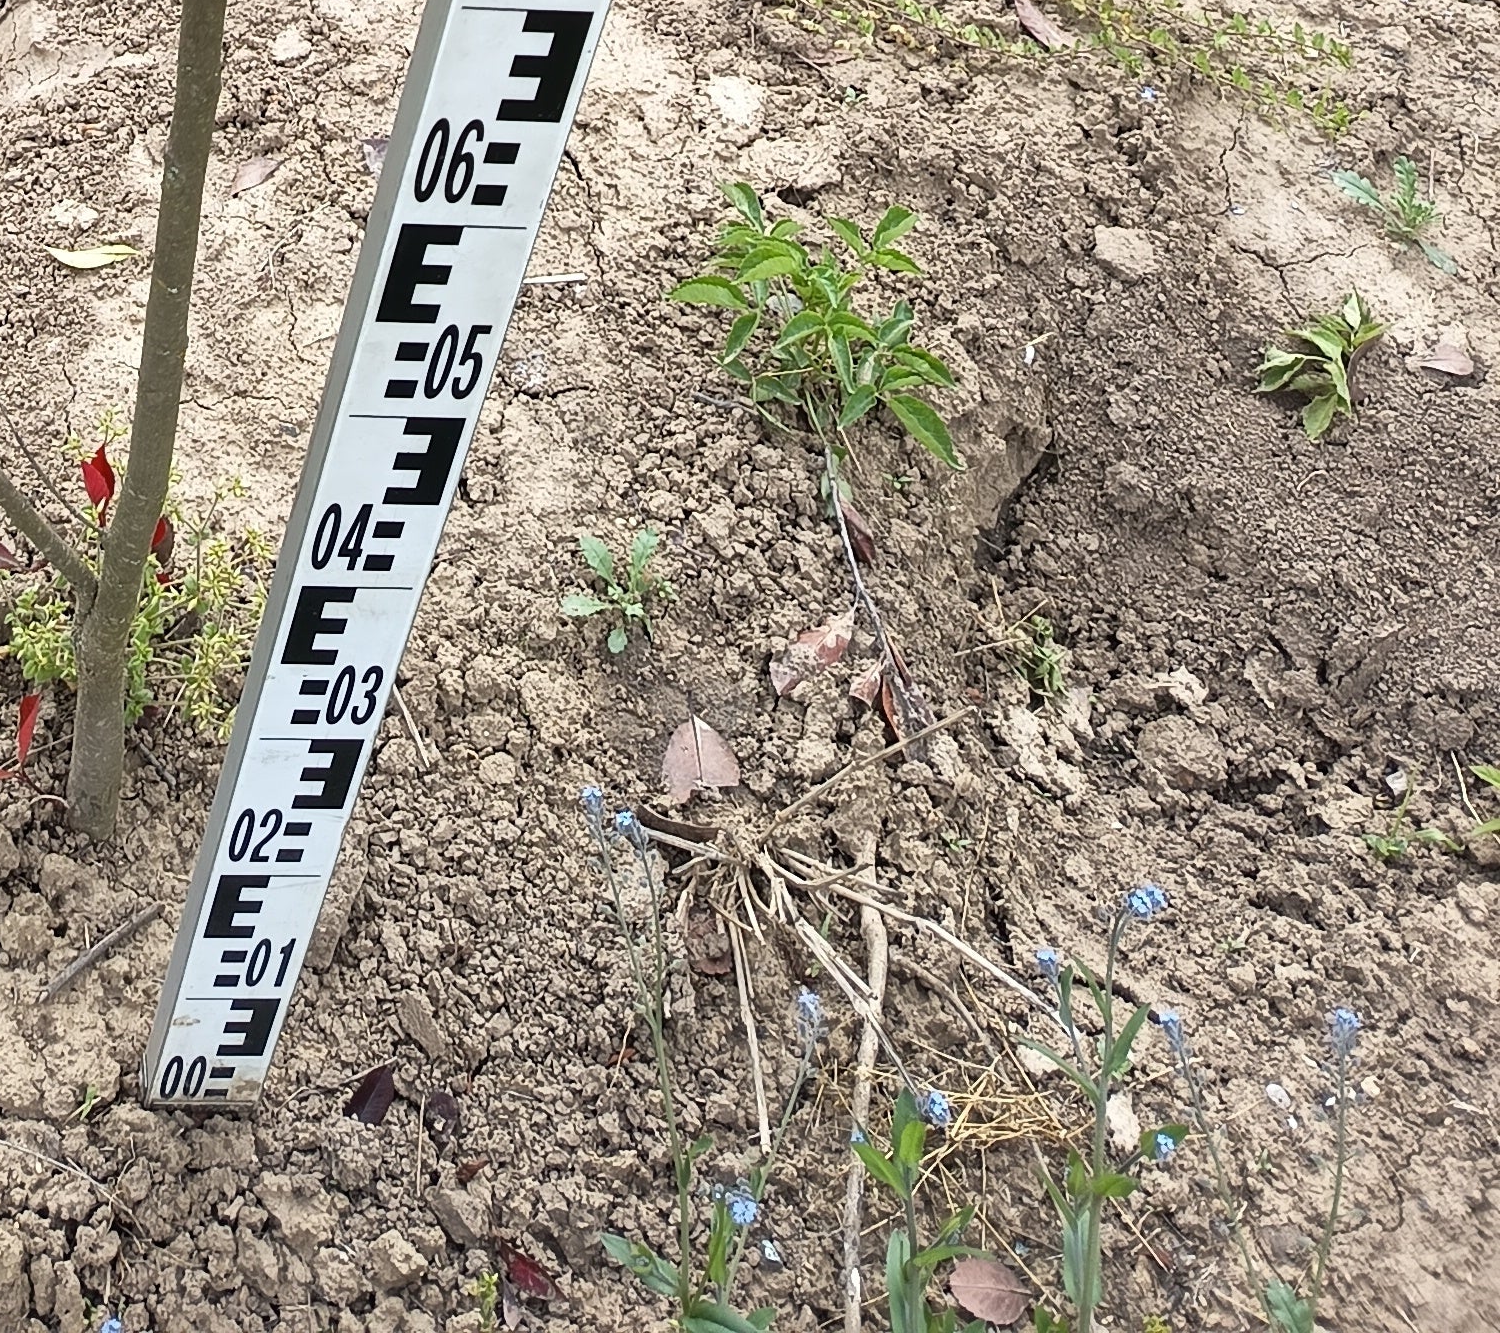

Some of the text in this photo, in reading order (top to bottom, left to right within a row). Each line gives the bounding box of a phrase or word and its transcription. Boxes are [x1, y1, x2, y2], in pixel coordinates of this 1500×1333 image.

[414, 117, 484, 206] 06
[423, 324, 492, 400] 05
[311, 502, 374, 572] 04
[325, 665, 383, 726] 03
[229, 807, 282, 863] 02
[245, 937, 296, 988] 01
[159, 1055, 207, 1099] 00
